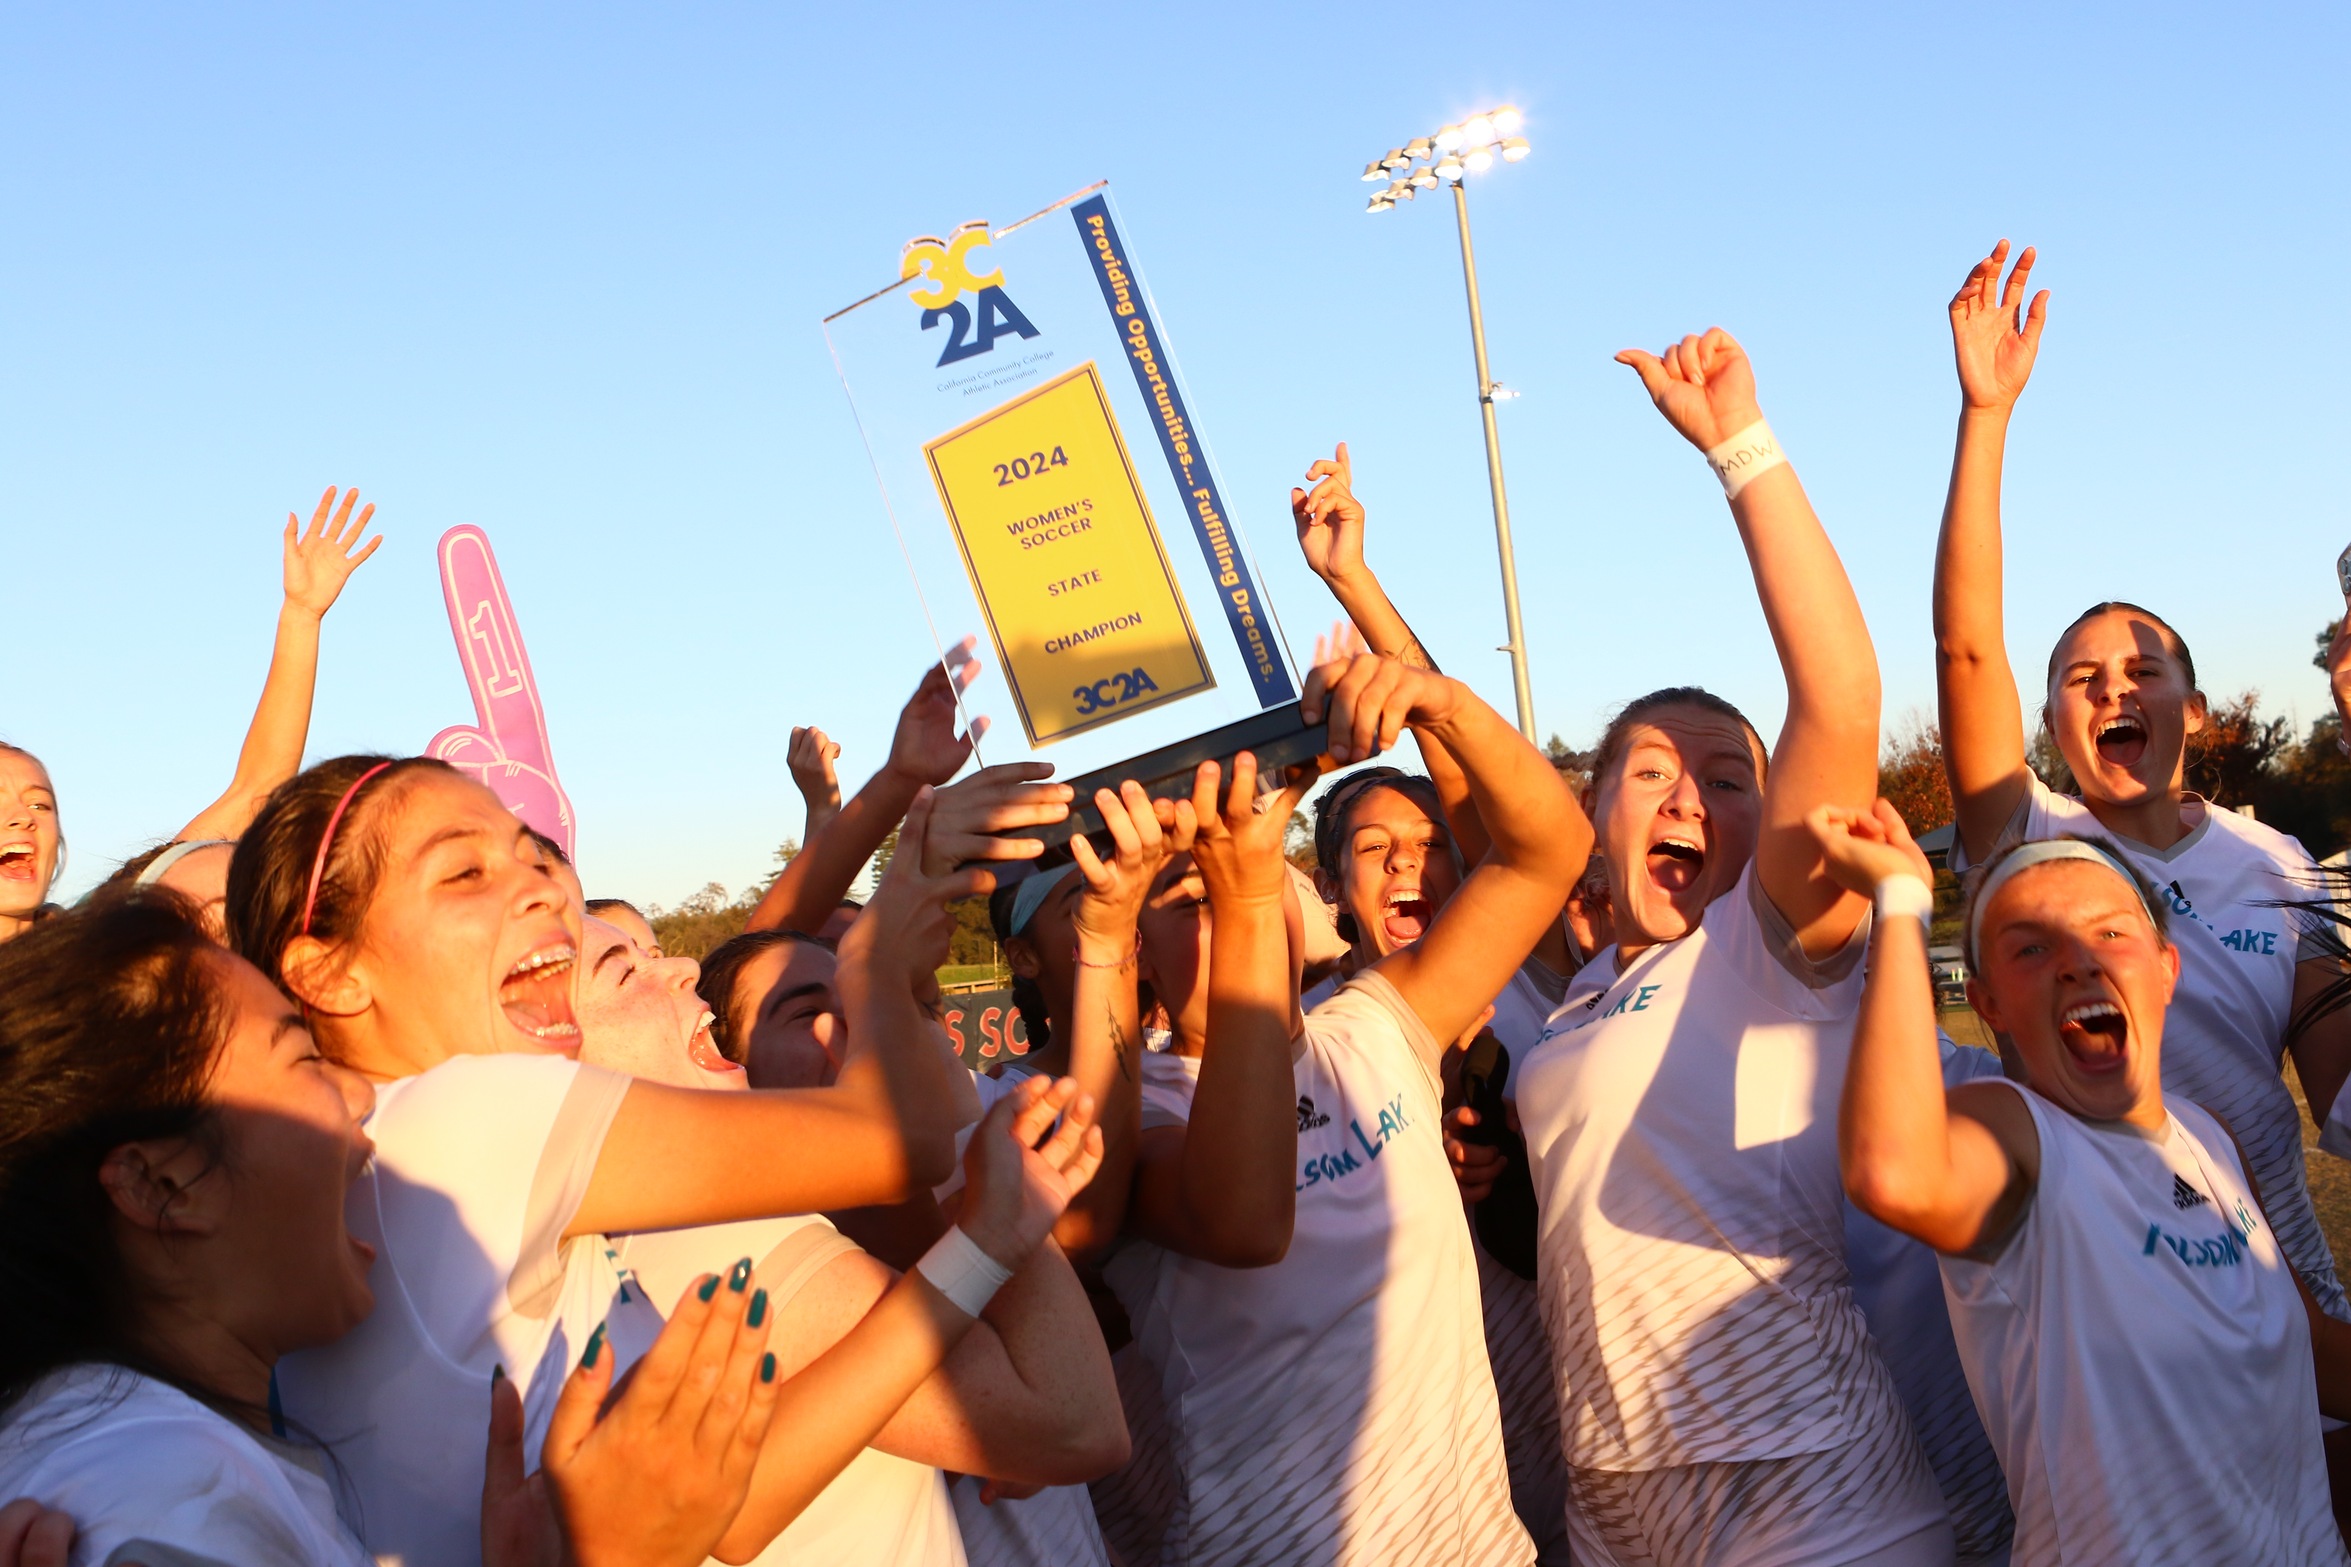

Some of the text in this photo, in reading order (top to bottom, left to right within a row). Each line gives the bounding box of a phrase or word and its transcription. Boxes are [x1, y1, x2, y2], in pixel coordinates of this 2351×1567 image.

[901, 226, 1006, 310] 3C
[920, 284, 1041, 369] 2A
[936, 350, 1055, 393] California Community College
[963, 368, 1038, 398] Athletic Association
[993, 445, 1069, 487] 2024
[1086, 214, 1274, 684] Providing Opportunities... Fulfilling Dreams.
[1720, 439, 1773, 477] MDW
[1006, 498, 1094, 536] WOMEN'S
[1020, 517, 1093, 550] SOCCER
[1047, 568, 1103, 597] STATE
[468, 599, 524, 698] 1
[1044, 611, 1143, 654] CHAMPION
[1072, 666, 1160, 715] 3C2A
